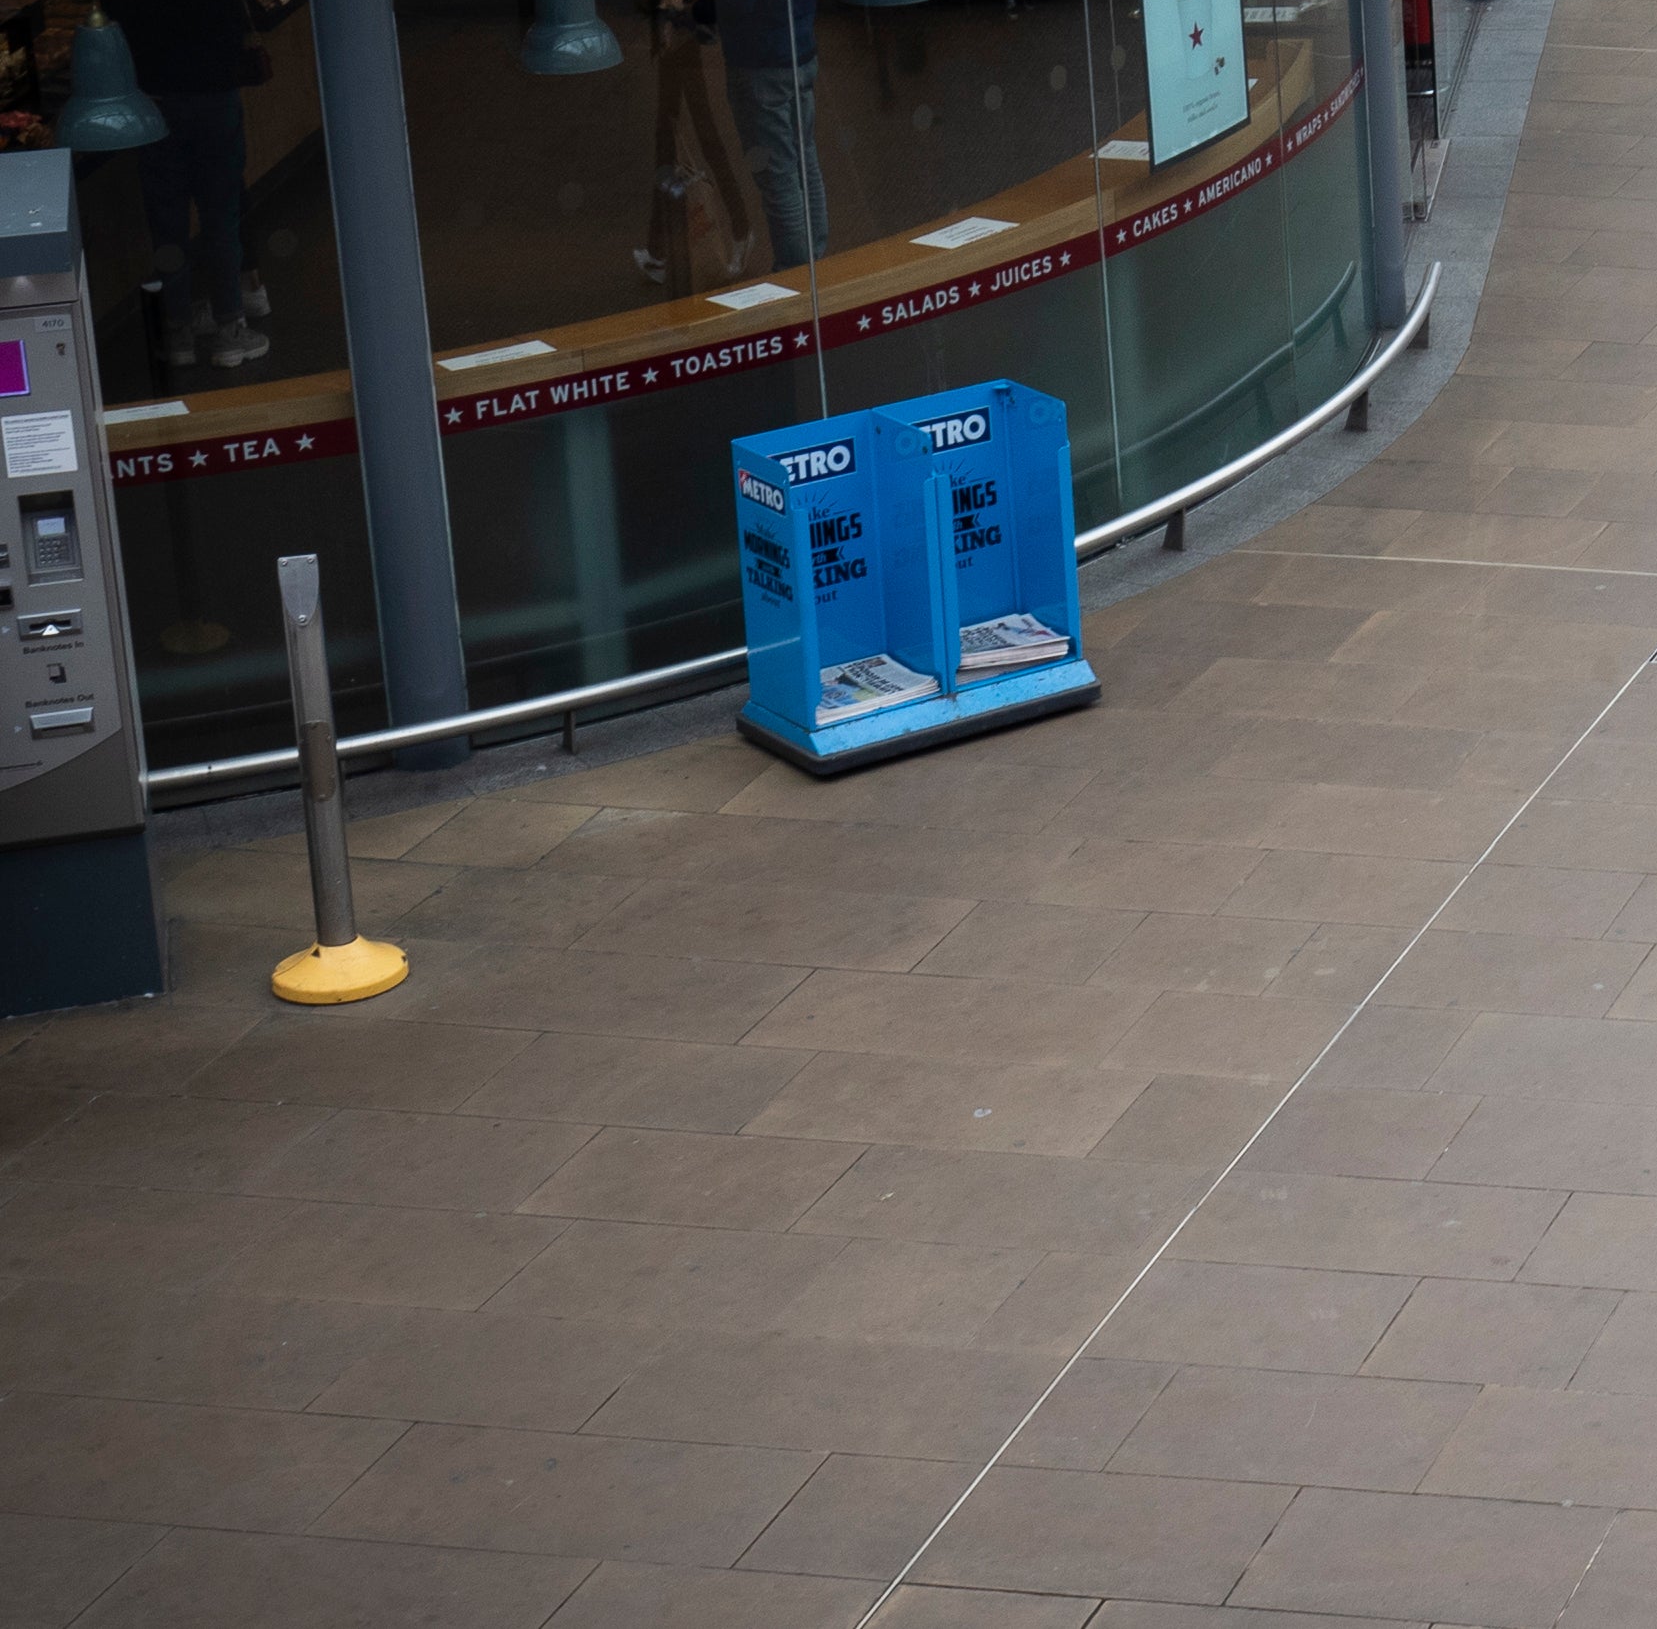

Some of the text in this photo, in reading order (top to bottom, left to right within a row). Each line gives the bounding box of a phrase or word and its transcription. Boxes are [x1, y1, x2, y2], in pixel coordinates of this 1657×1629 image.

[1295, 114, 1322, 146] WRAPS
[1132, 158, 1263, 239] CAKES AMERICANO
[881, 255, 1053, 325] SALADS JUICES
[671, 335, 784, 379] TOASTIES
[476, 372, 631, 421] FLAT WHITE
[110, 437, 280, 480] NTS TEA
[742, 478, 785, 513] METRO
[747, 566, 793, 601] TALKING
